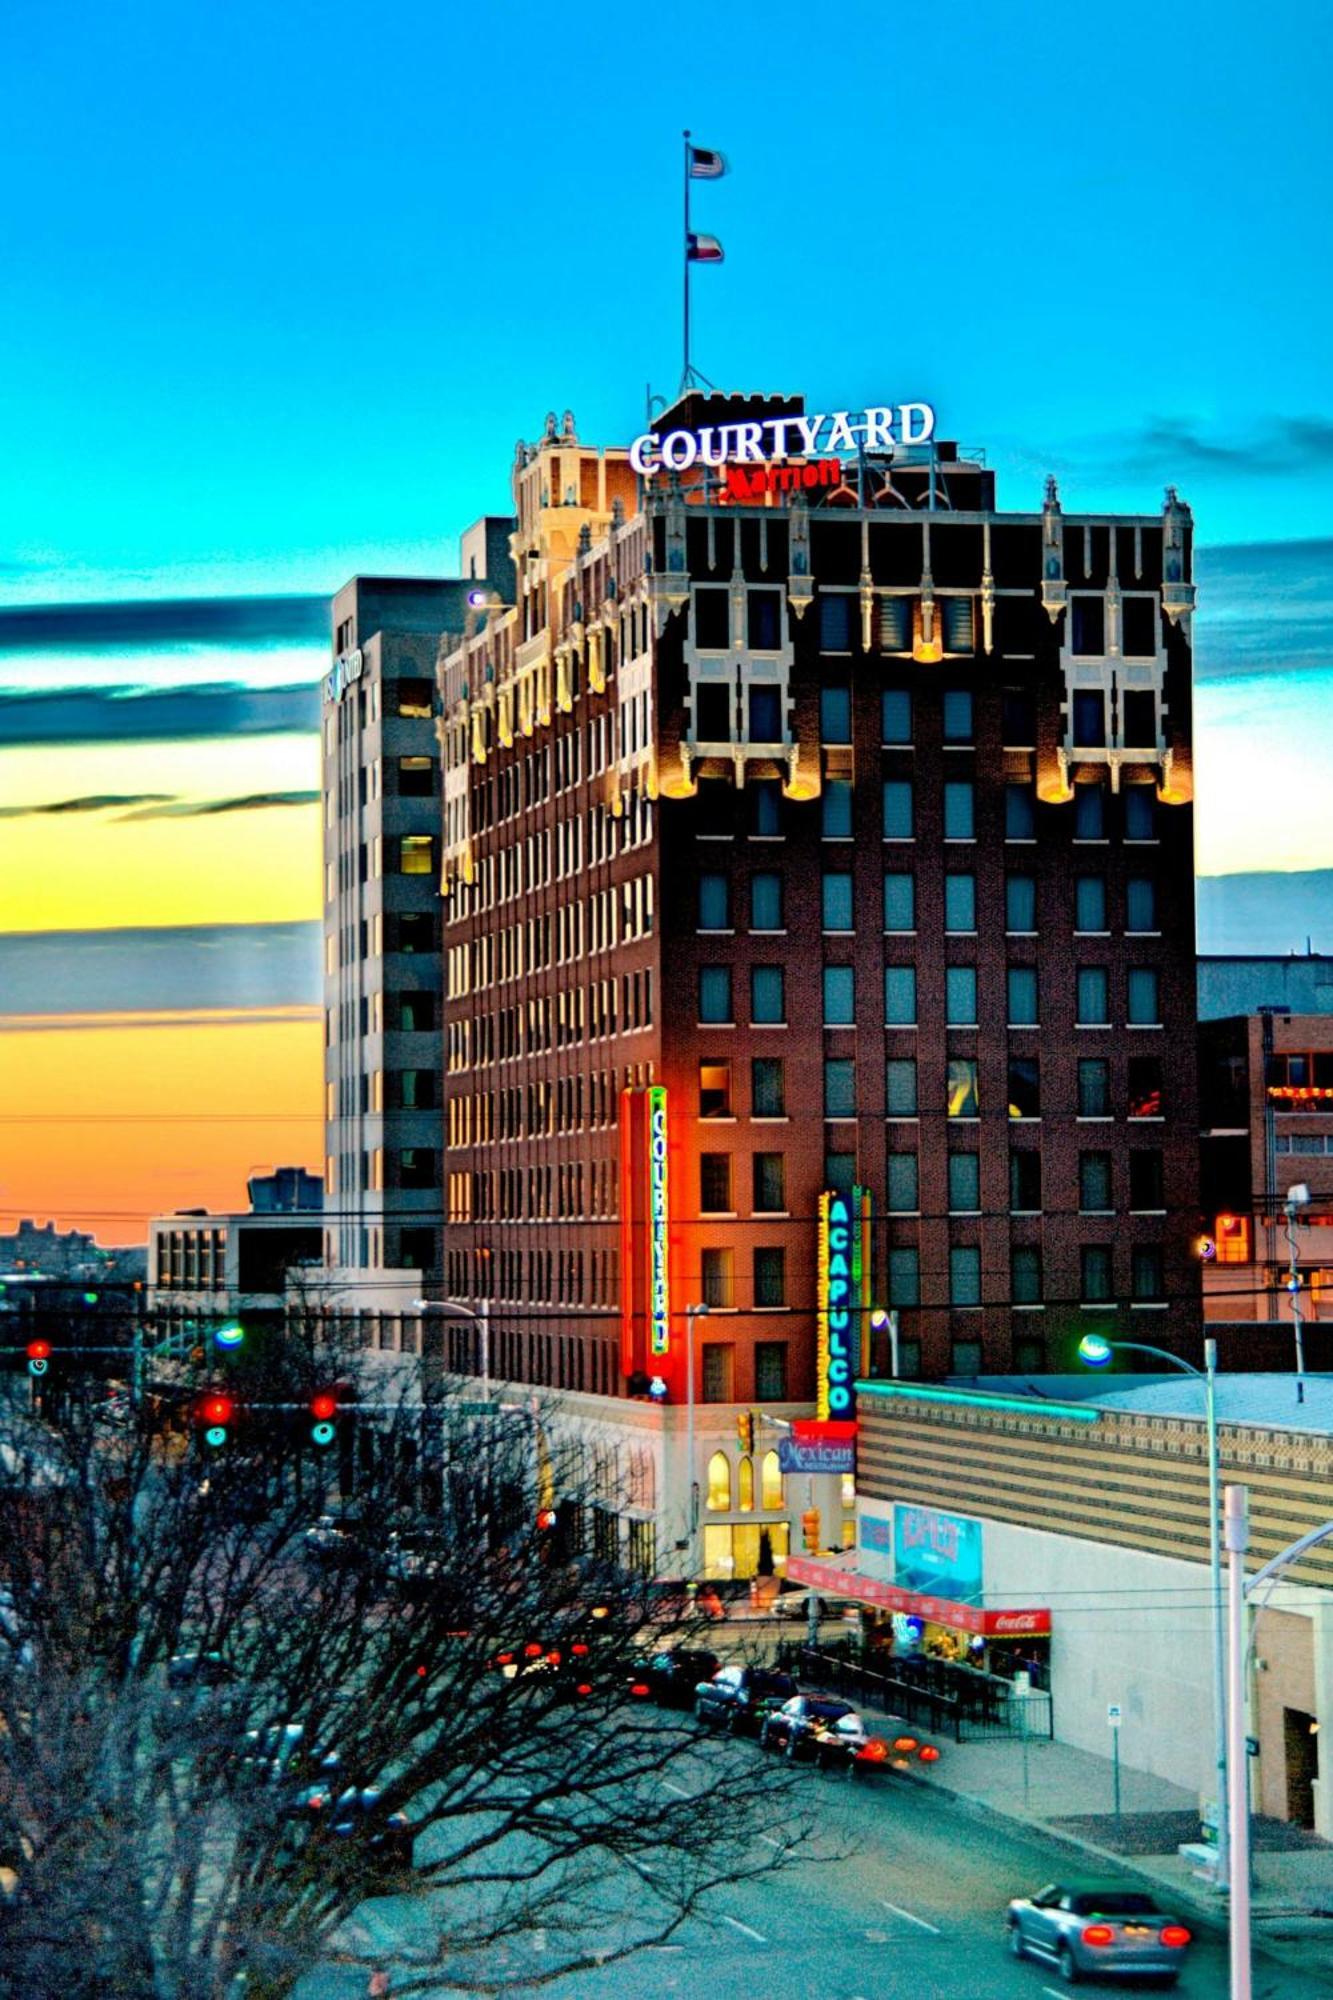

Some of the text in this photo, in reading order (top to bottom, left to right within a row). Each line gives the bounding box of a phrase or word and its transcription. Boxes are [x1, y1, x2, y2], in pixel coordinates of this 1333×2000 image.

[629, 402, 935, 474] COURTYARD
[828, 1200, 849, 1411] ACAPULCO
[781, 1441, 854, 1470] Mexican
